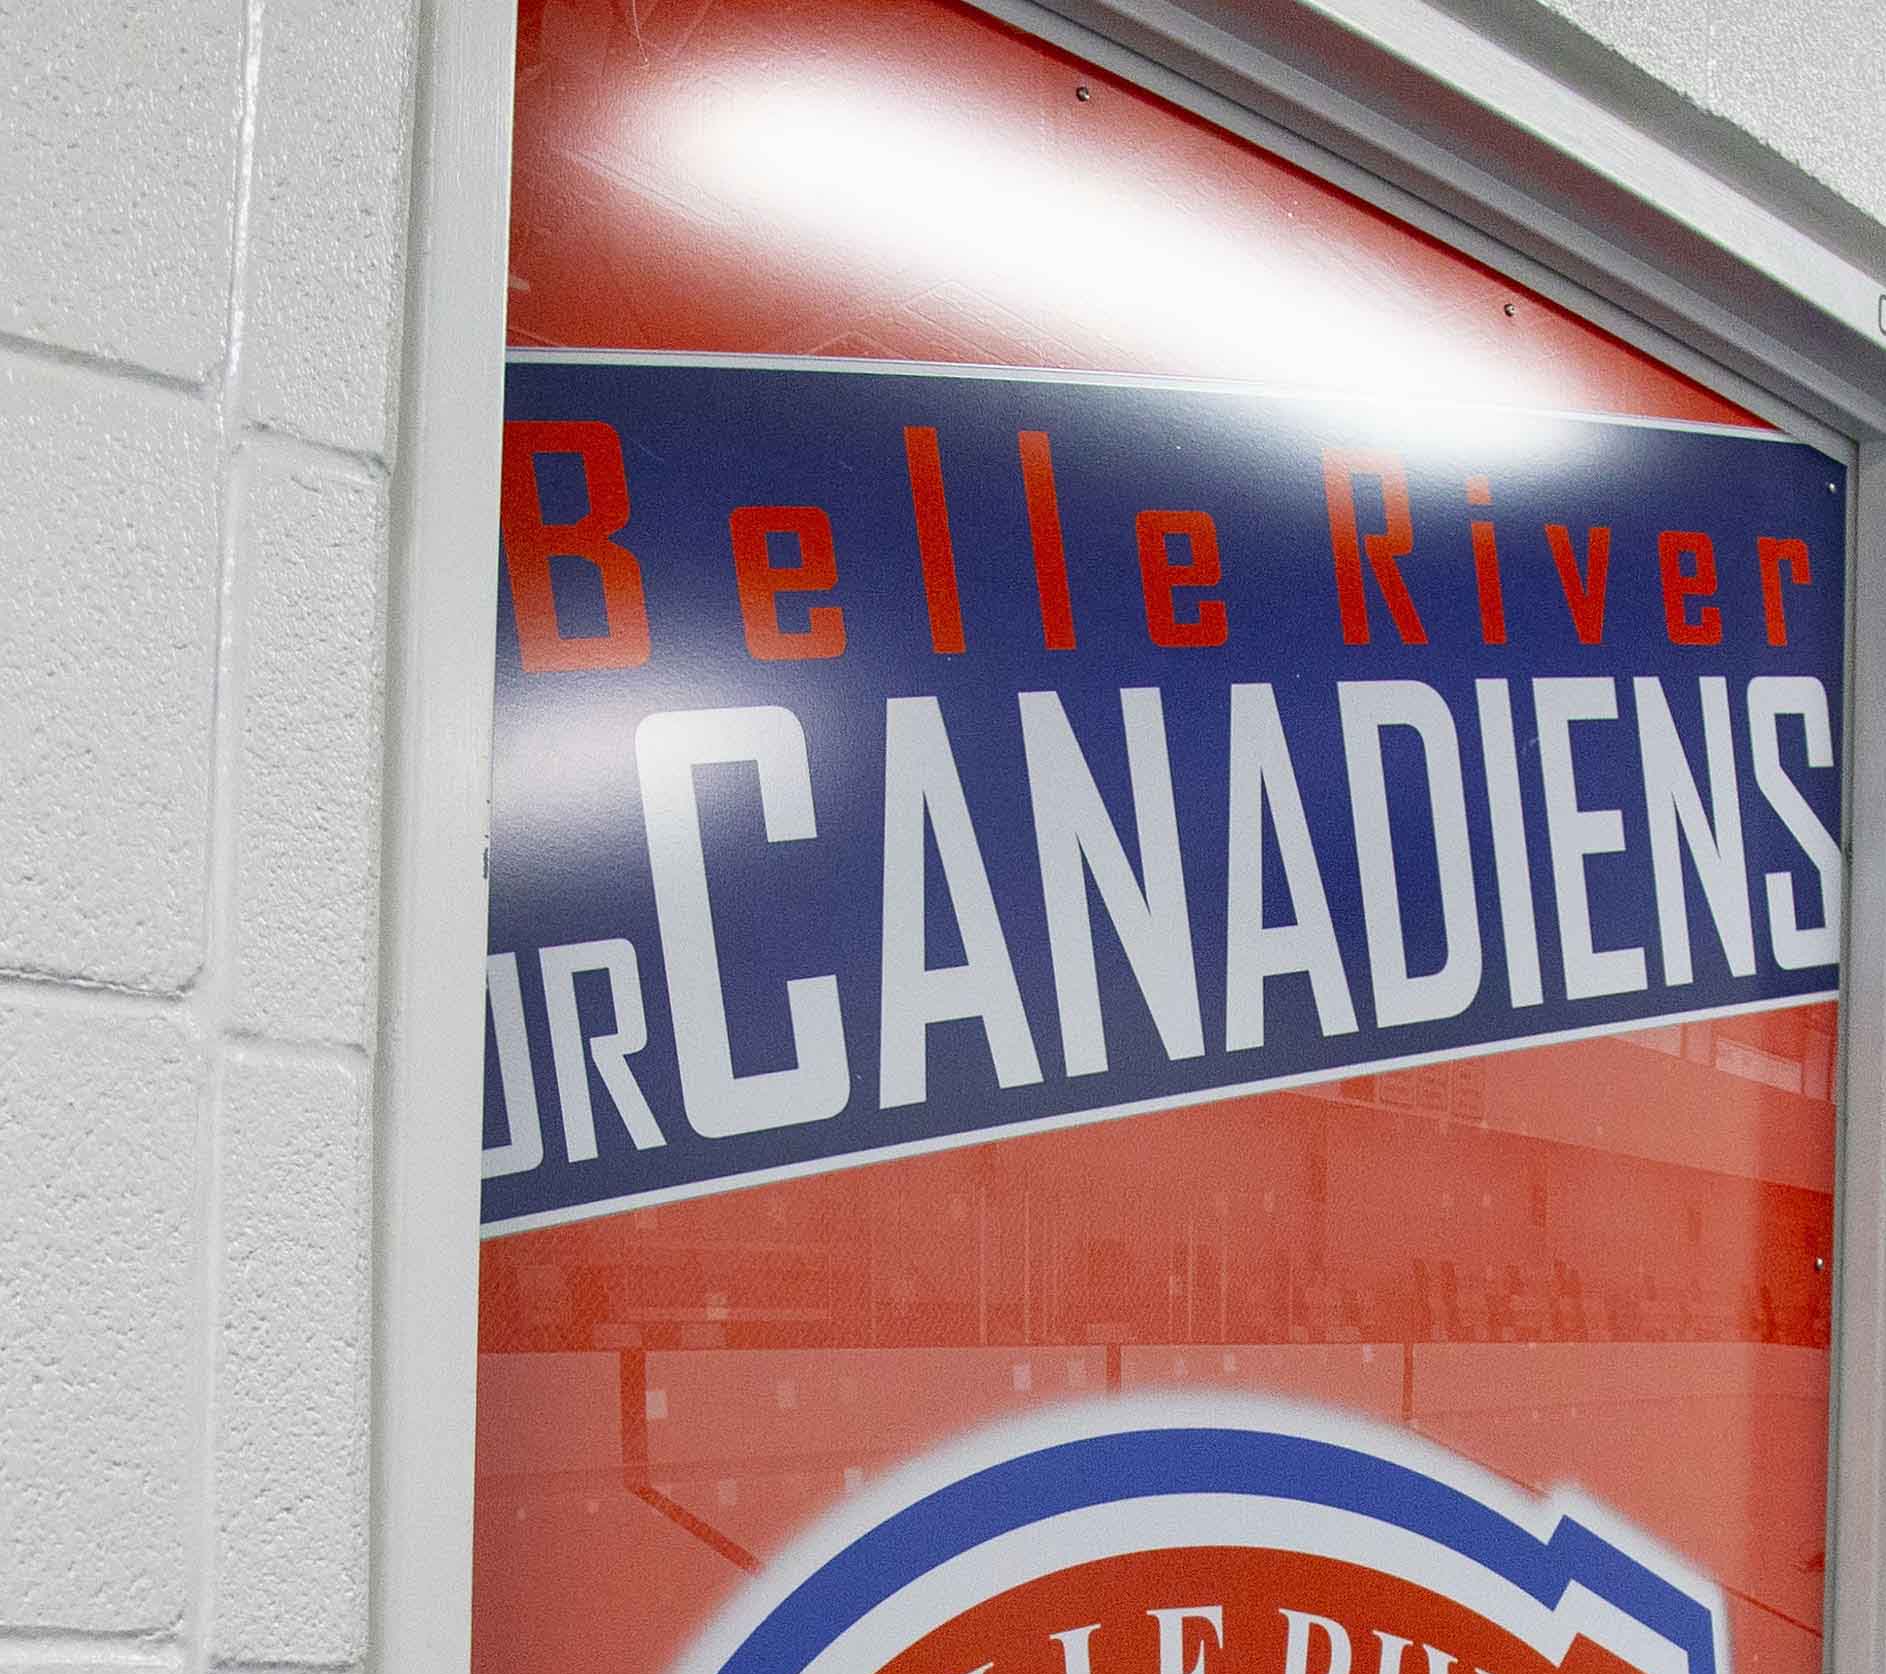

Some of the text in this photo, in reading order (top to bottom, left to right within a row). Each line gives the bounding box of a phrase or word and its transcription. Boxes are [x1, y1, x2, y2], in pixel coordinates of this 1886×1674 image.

[503, 419, 1813, 672] Belle River
[635, 675, 1843, 1139] CANADIENS
